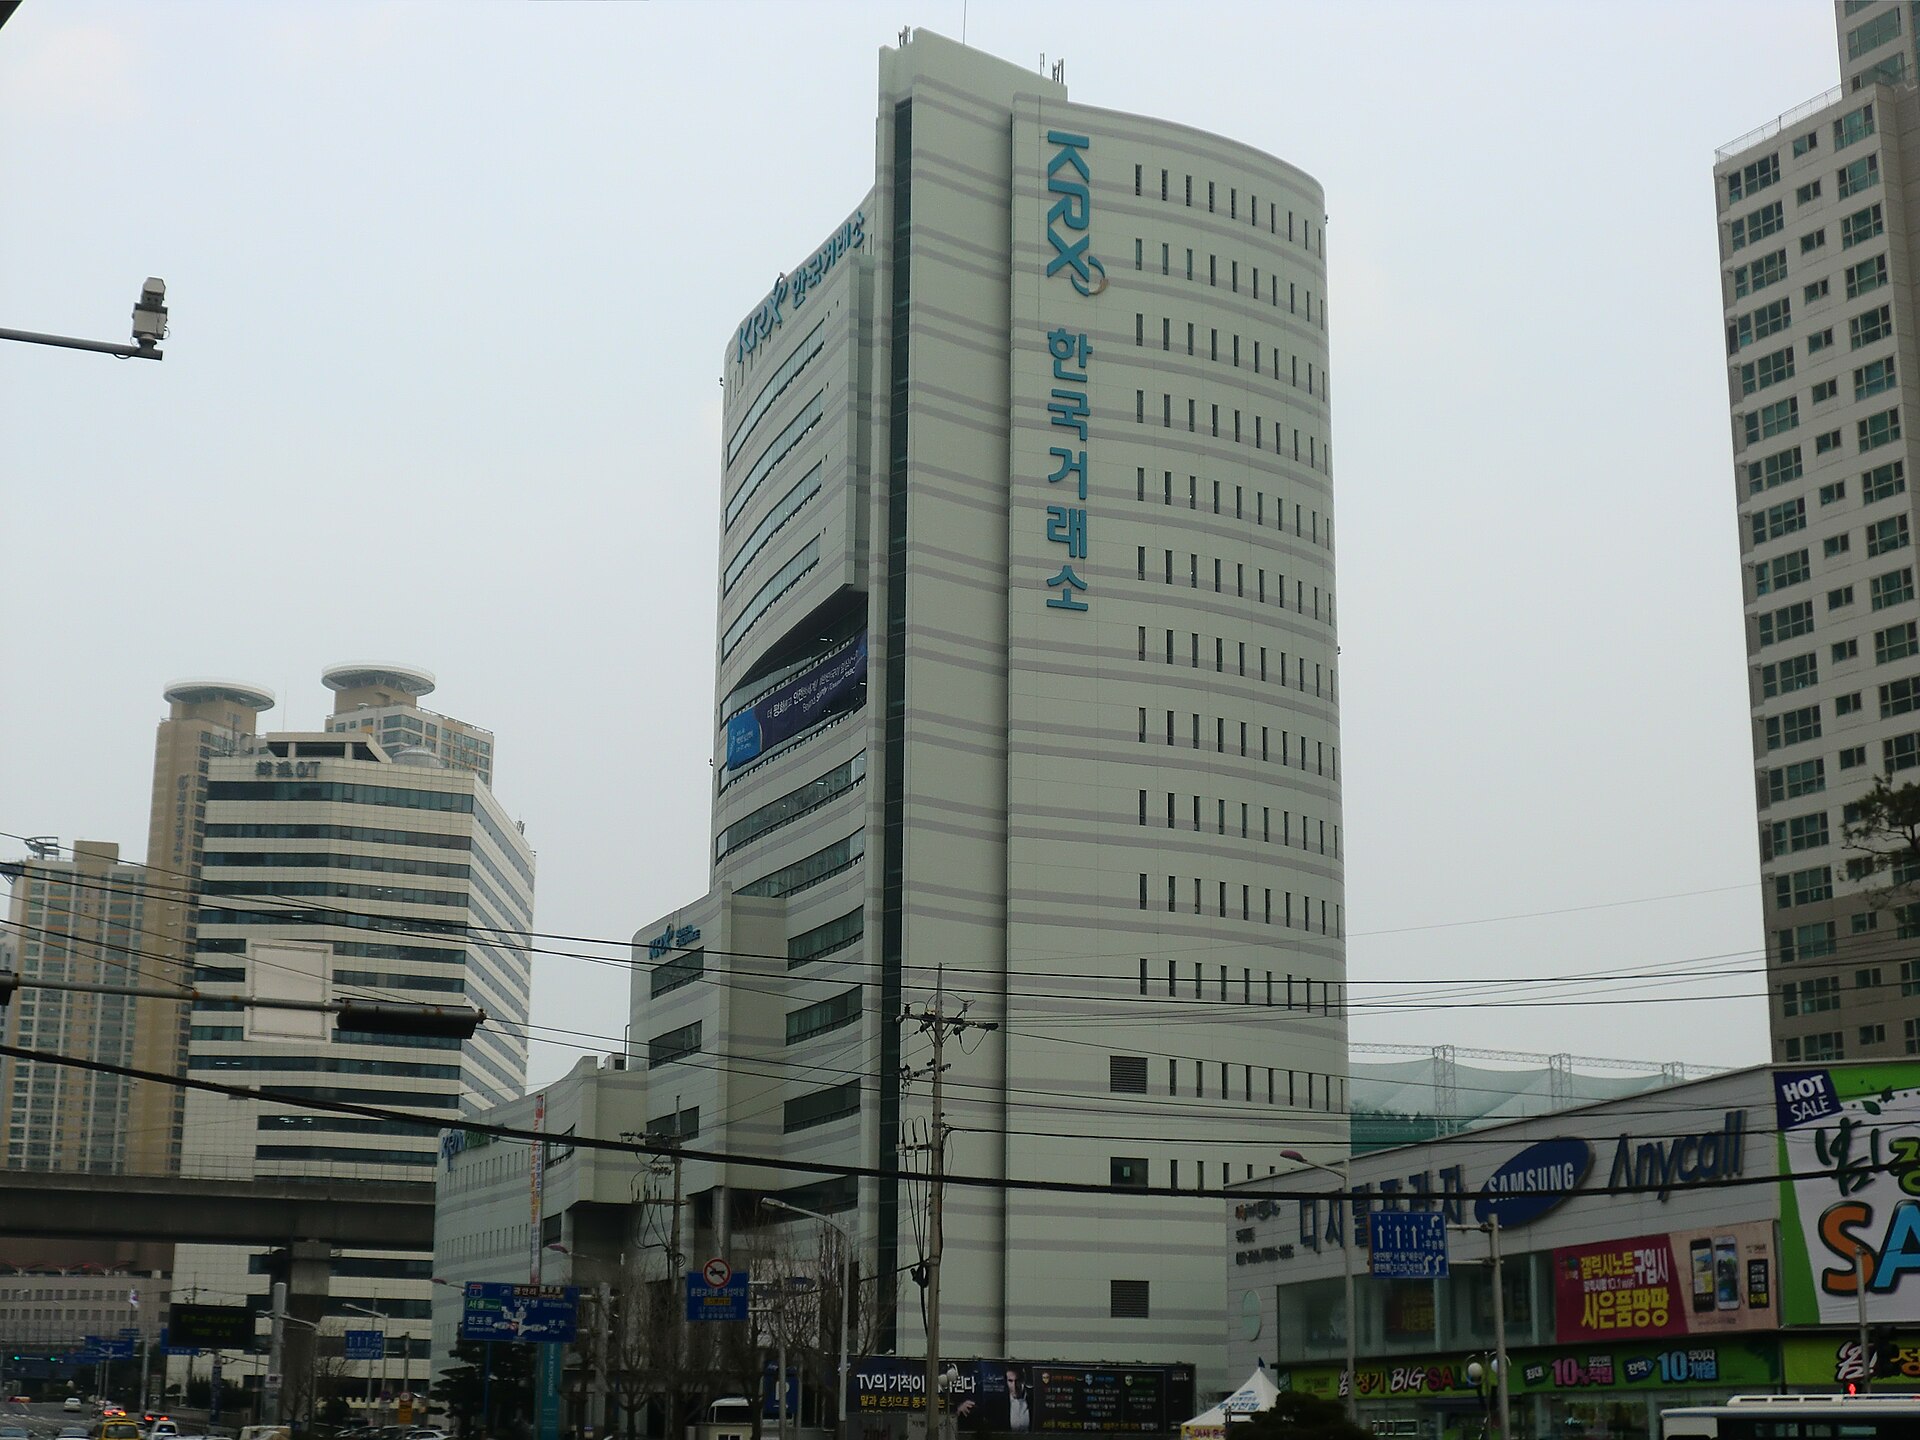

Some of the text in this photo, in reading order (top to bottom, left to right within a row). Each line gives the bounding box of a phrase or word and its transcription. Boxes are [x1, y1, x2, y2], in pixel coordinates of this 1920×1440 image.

[1047, 129, 1098, 288] KRX
[793, 211, 865, 310] 한국거래소
[736, 274, 788, 364] KRX
[1046, 328, 1094, 612] 한국거래소
[1782, 1075, 1826, 1102] HOT
[1790, 1095, 1831, 1122] SALE
[1609, 1109, 1747, 1202] Anycall
[1487, 1161, 1575, 1204] SAMSUNG
[1580, 1251, 1634, 1279] 갤럭시노트
[1634, 1247, 1669, 1285] 구입시
[468, 1299, 485, 1309] 서울
[513, 1287, 537, 1296] 광안리
[513, 1298, 538, 1308] 남구청
[467, 1316, 493, 1326] 전포동
[1580, 1287, 1669, 1330] 사은품팡팡
[1657, 1350, 1688, 1381] 10
[1687, 1349, 1715, 1361] 무이자
[856, 1374, 887, 1392] TV의
[889, 1374, 926, 1393] 기적이
[1356, 1371, 1385, 1393] 정기
[1391, 1366, 1426, 1392] BIG
[1526, 1366, 1543, 1379] 최대
[1552, 1358, 1590, 1387] 10%
[1688, 1361, 1717, 1380] 개월
[860, 1394, 877, 1407] 말과
[879, 1396, 910, 1408] 손짓으로
